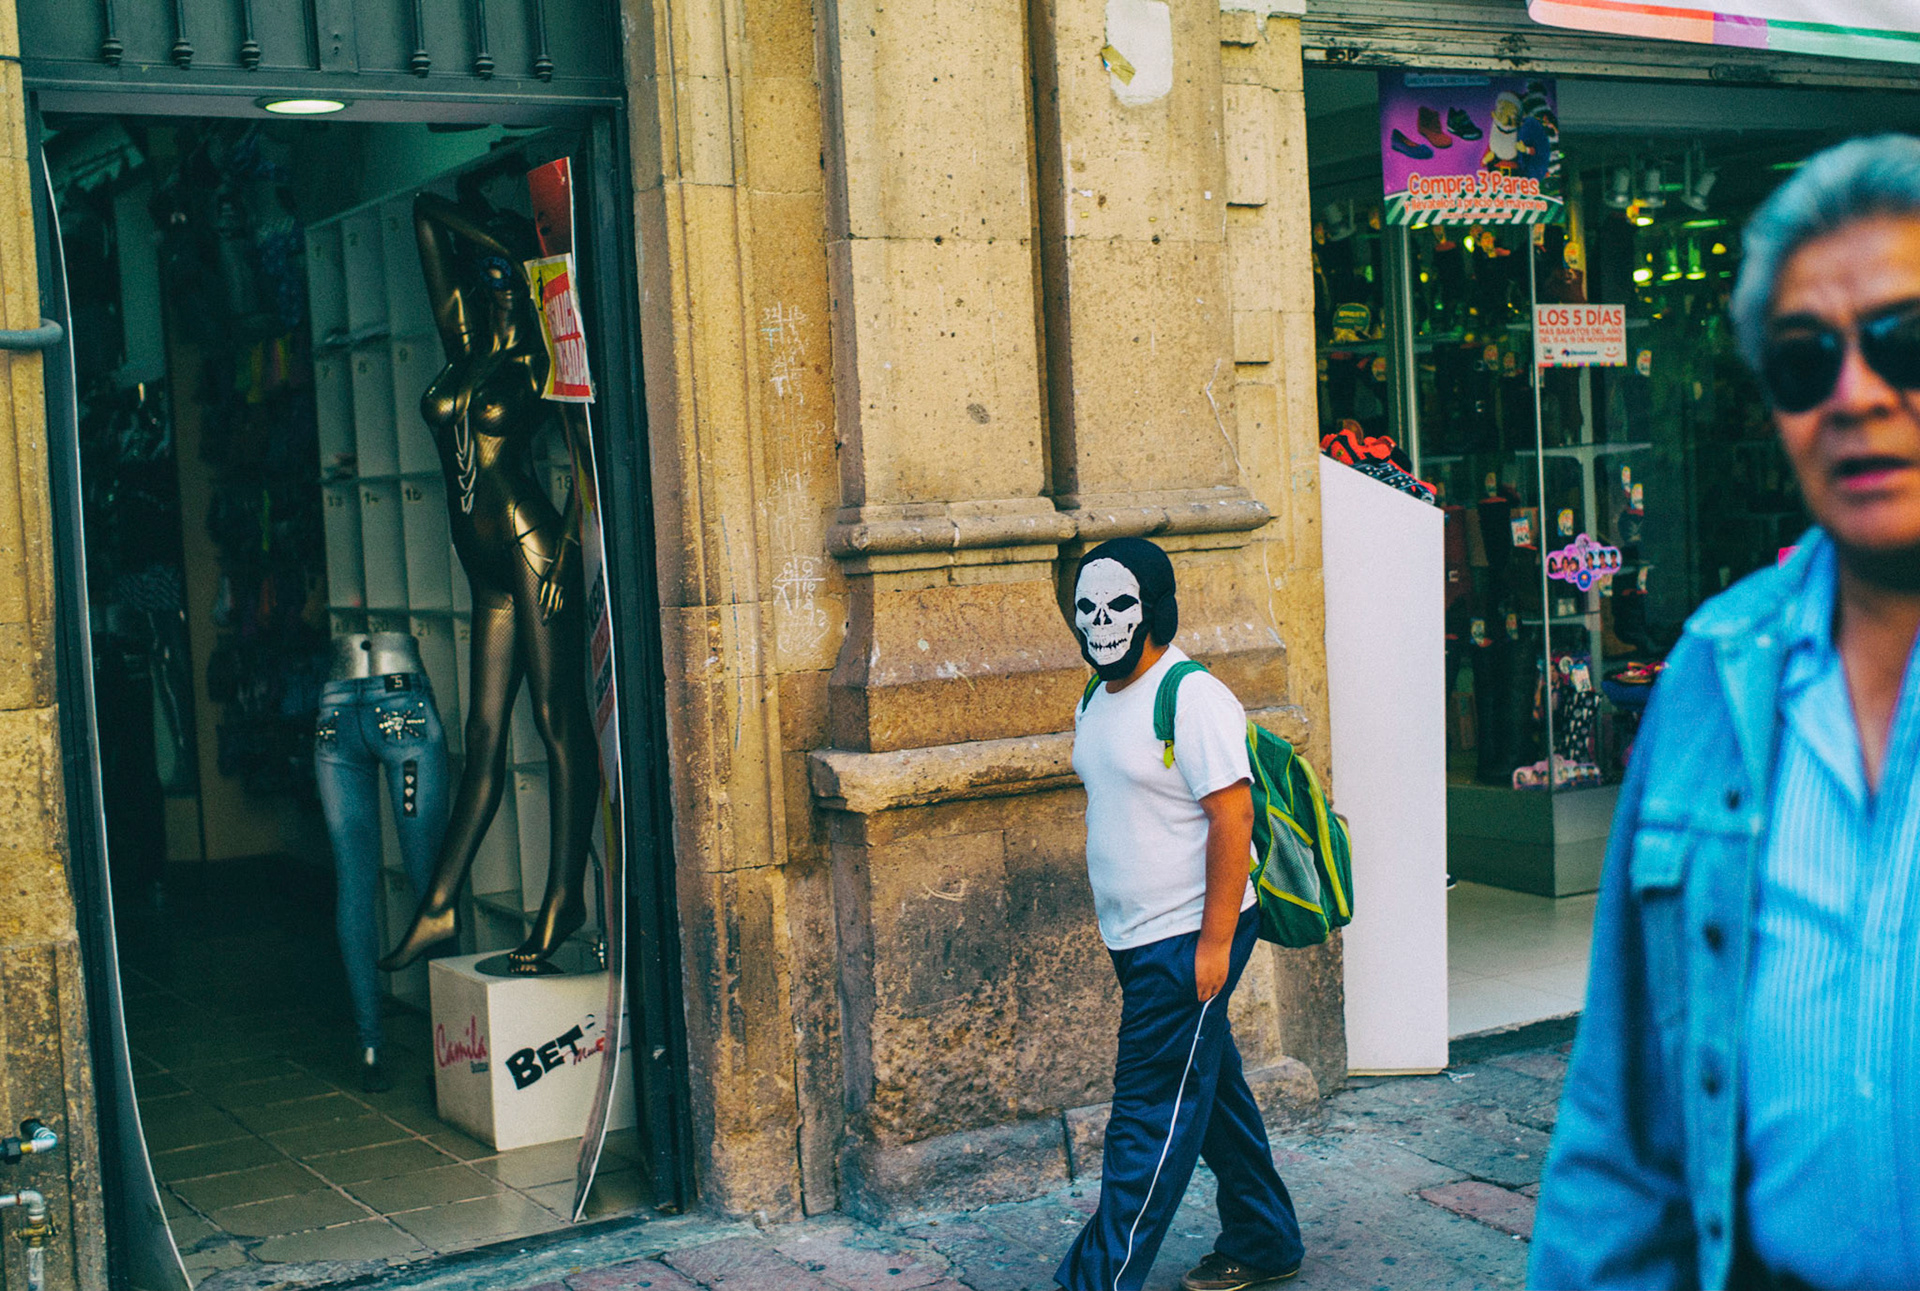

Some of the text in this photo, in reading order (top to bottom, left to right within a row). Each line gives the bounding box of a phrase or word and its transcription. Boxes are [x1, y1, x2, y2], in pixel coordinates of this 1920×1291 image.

[1409, 171, 1539, 197] Compra 3 Pares
[1538, 305, 1622, 326] LOS 5 DÍAS
[436, 1014, 488, 1068] Camila
